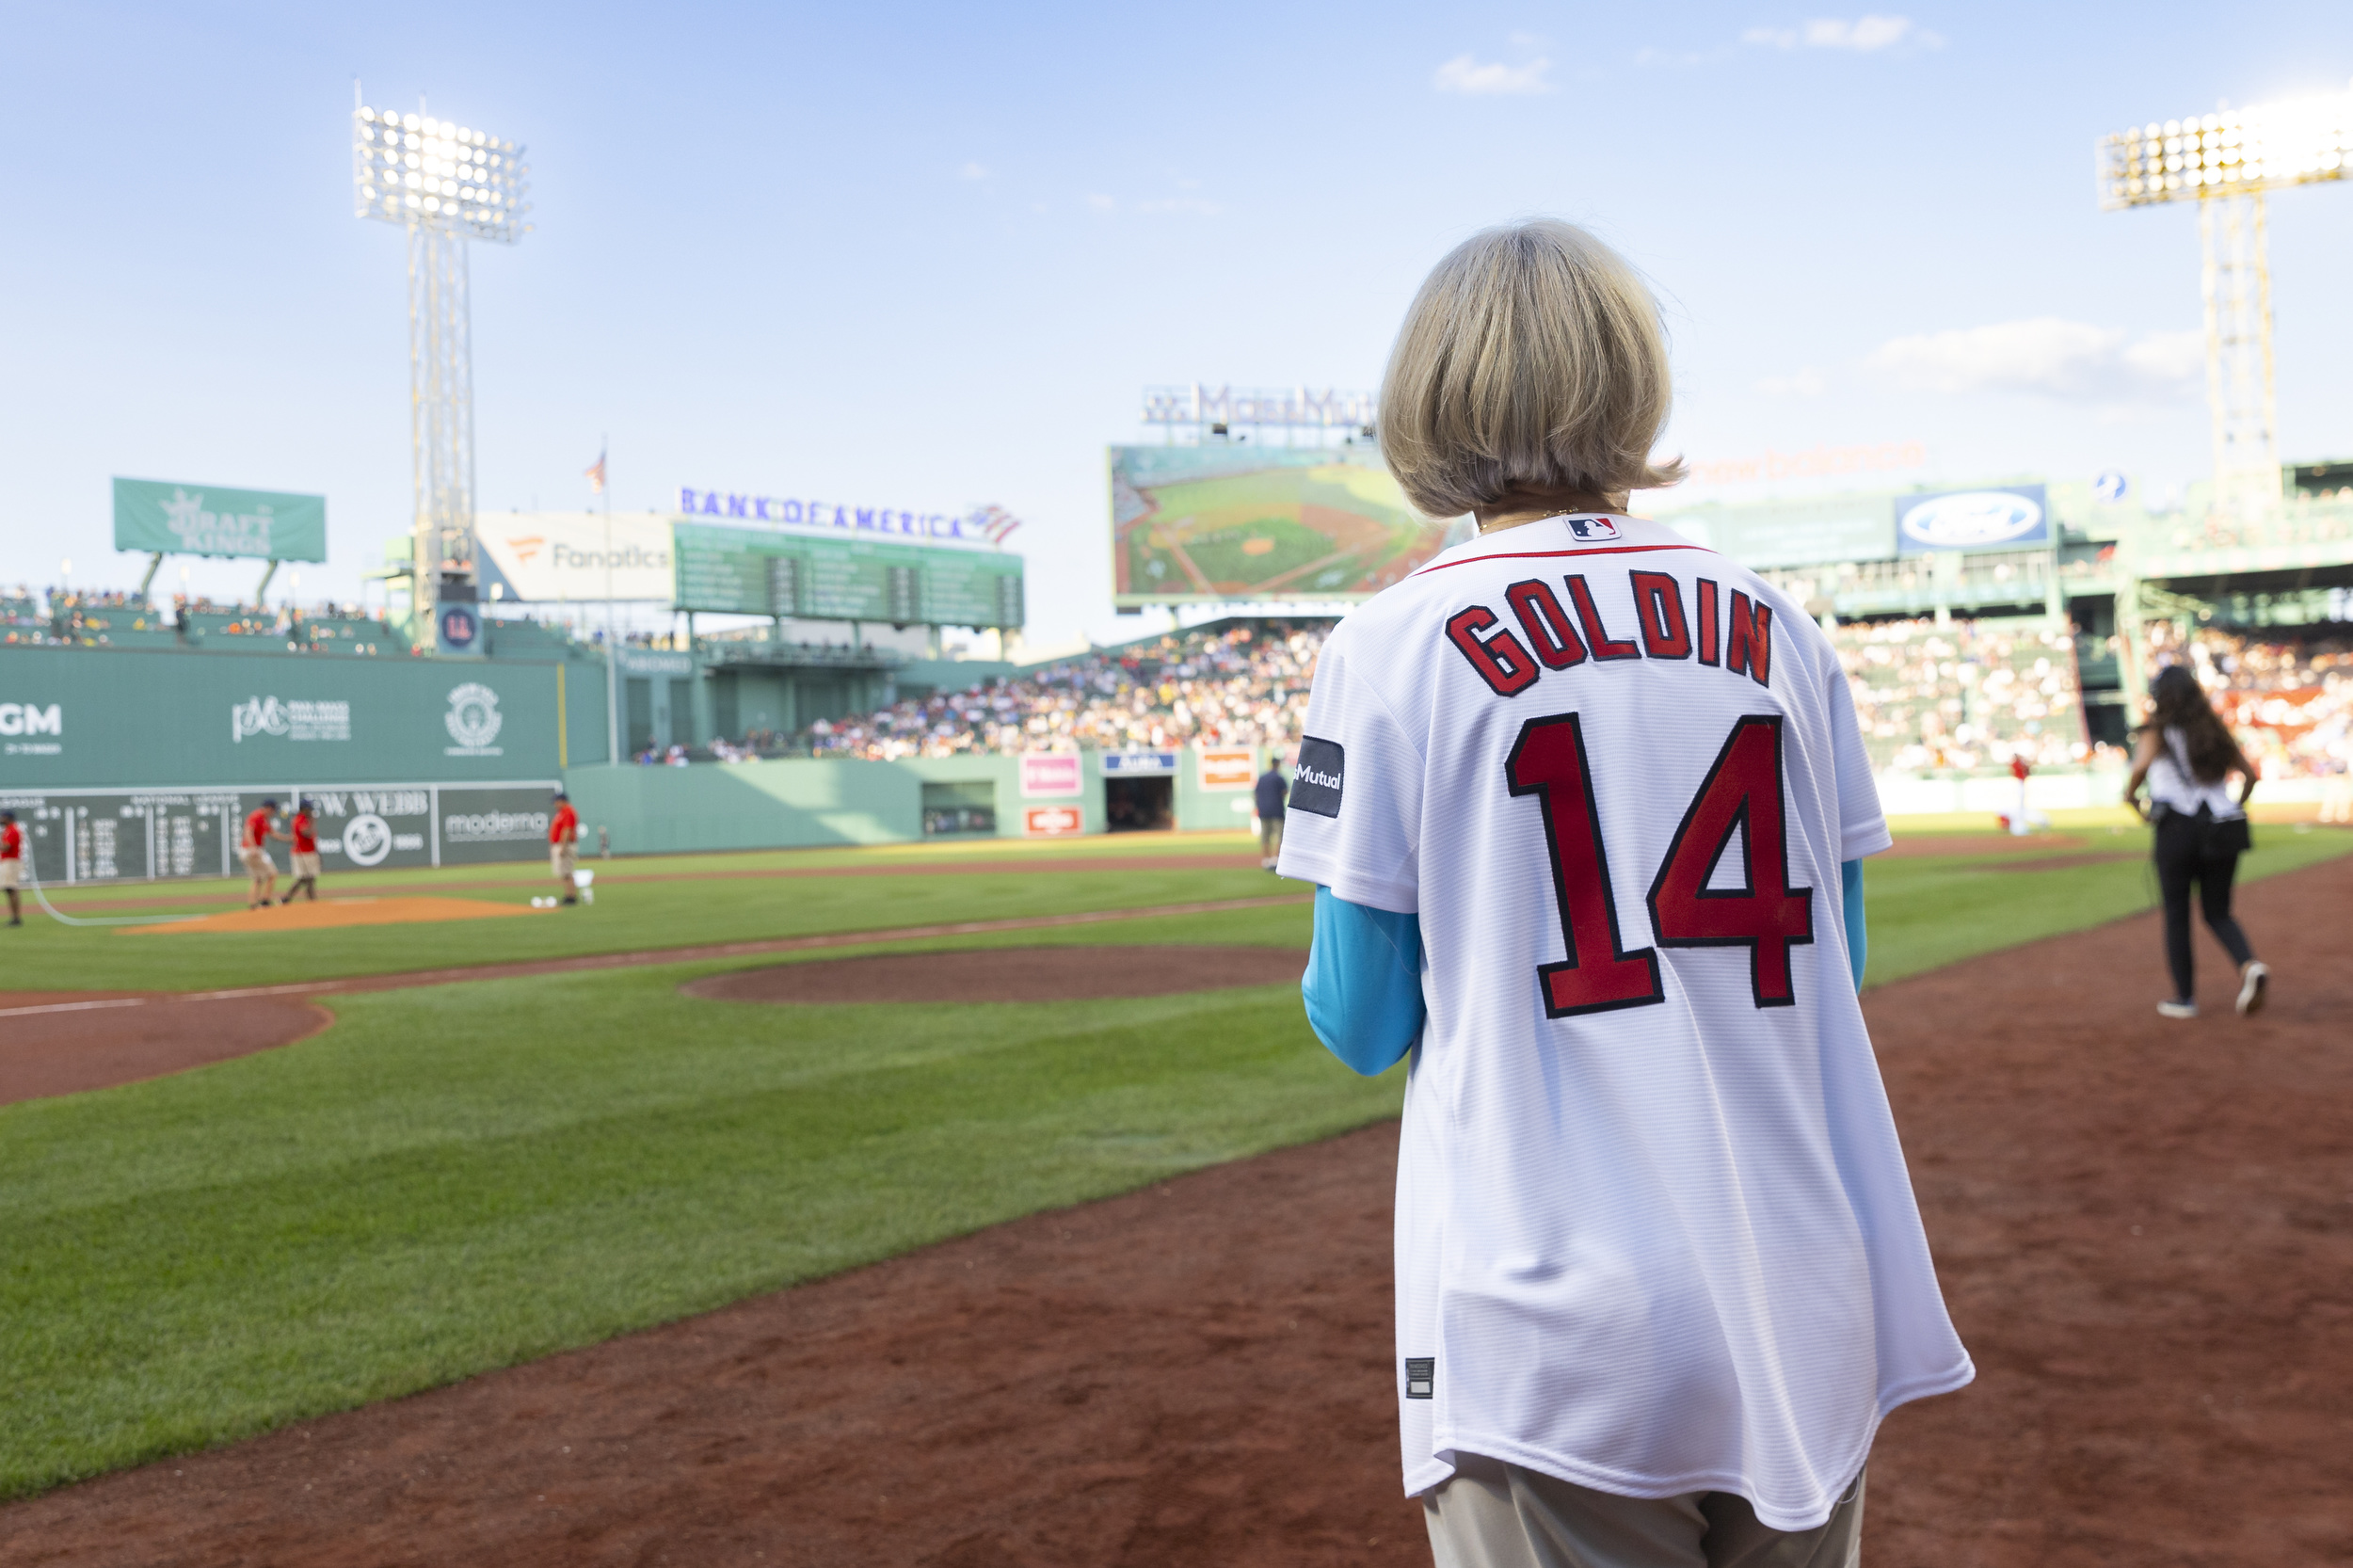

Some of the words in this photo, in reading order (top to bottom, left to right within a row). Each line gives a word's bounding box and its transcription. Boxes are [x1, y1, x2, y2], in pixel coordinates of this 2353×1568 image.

[1765, 440, 1926, 482] balance
[680, 486, 772, 520] BANK
[782, 498, 820, 525] OF
[832, 504, 965, 539] AMERICA
[182, 531, 273, 555] KINGS
[552, 542, 669, 568] Fanatics
[1446, 569, 1772, 697] GOLDIN
[0, 702, 62, 736] GM
[352, 792, 429, 816] WEBB
[444, 808, 550, 835] moderna
[1504, 712, 1815, 1019] 14
